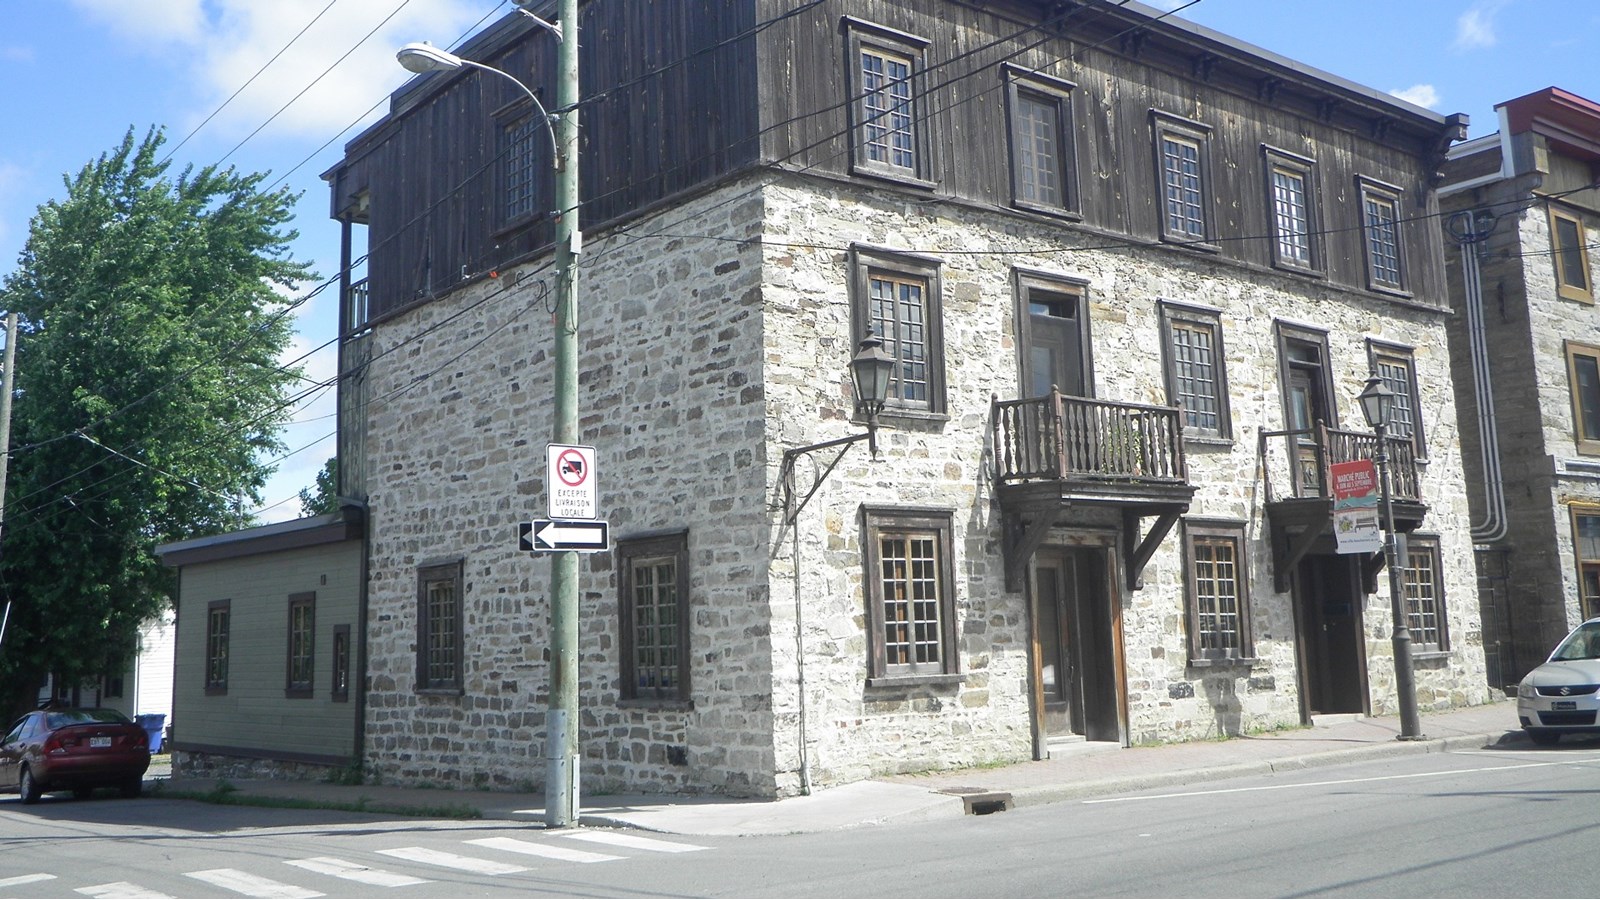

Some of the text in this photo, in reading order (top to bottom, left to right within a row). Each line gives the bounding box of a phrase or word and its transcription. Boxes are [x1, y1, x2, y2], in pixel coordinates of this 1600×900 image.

[1355, 471, 1370, 480] PUBLIC
[555, 499, 590, 507] LIVRAISON
[561, 508, 584, 516] LOCALE
